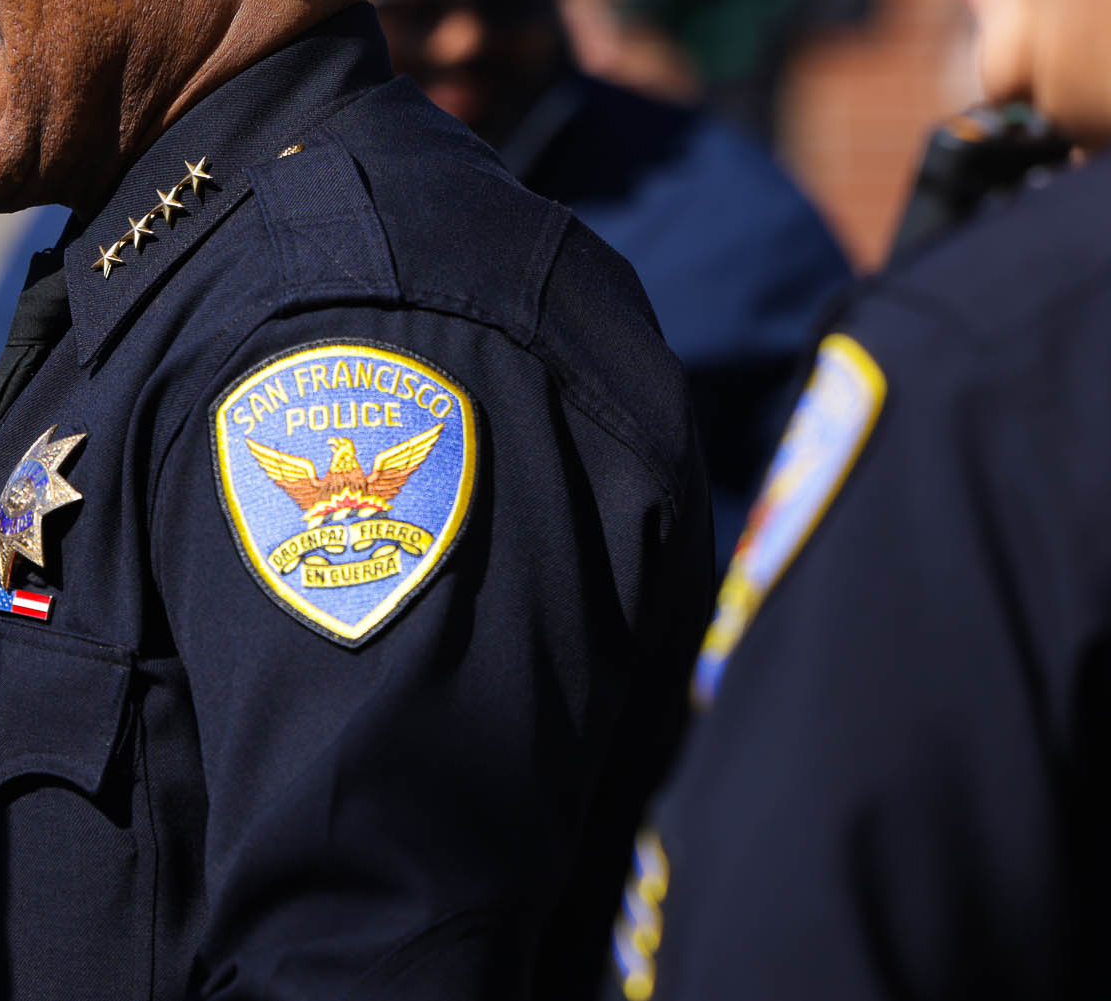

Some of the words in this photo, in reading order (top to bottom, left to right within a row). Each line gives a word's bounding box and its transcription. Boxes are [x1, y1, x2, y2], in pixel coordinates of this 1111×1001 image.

[233, 378, 290, 435] SAN
[294, 360, 453, 419] FRANCISCO
[285, 401, 403, 436] POLICE
[272, 541, 299, 566] ORO
[301, 534, 318, 550] EN
[319, 528, 345, 546] PAZ
[360, 524, 422, 544] FIERRO
[305, 569, 325, 583] EN
[330, 557, 398, 584] GUERRA
